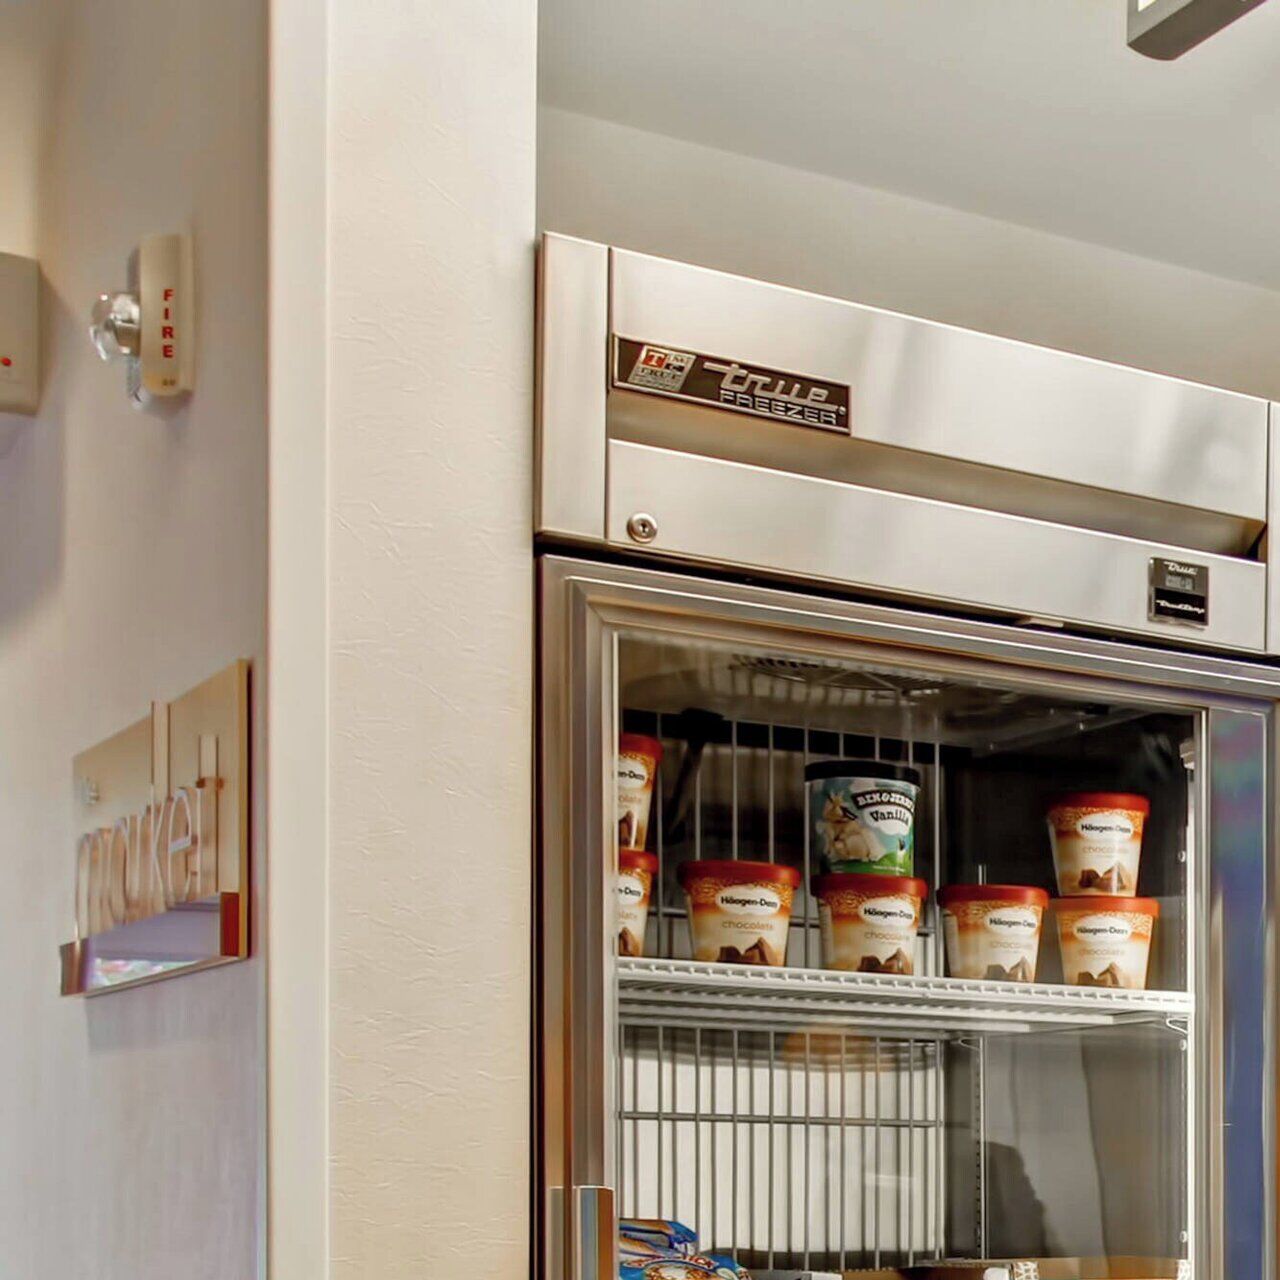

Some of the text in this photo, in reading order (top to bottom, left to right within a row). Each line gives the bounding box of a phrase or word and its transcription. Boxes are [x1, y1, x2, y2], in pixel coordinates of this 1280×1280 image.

[162, 288, 175, 358] FIRE
[719, 389, 837, 425] FREEZER
[869, 809, 910, 827] Vanilla
